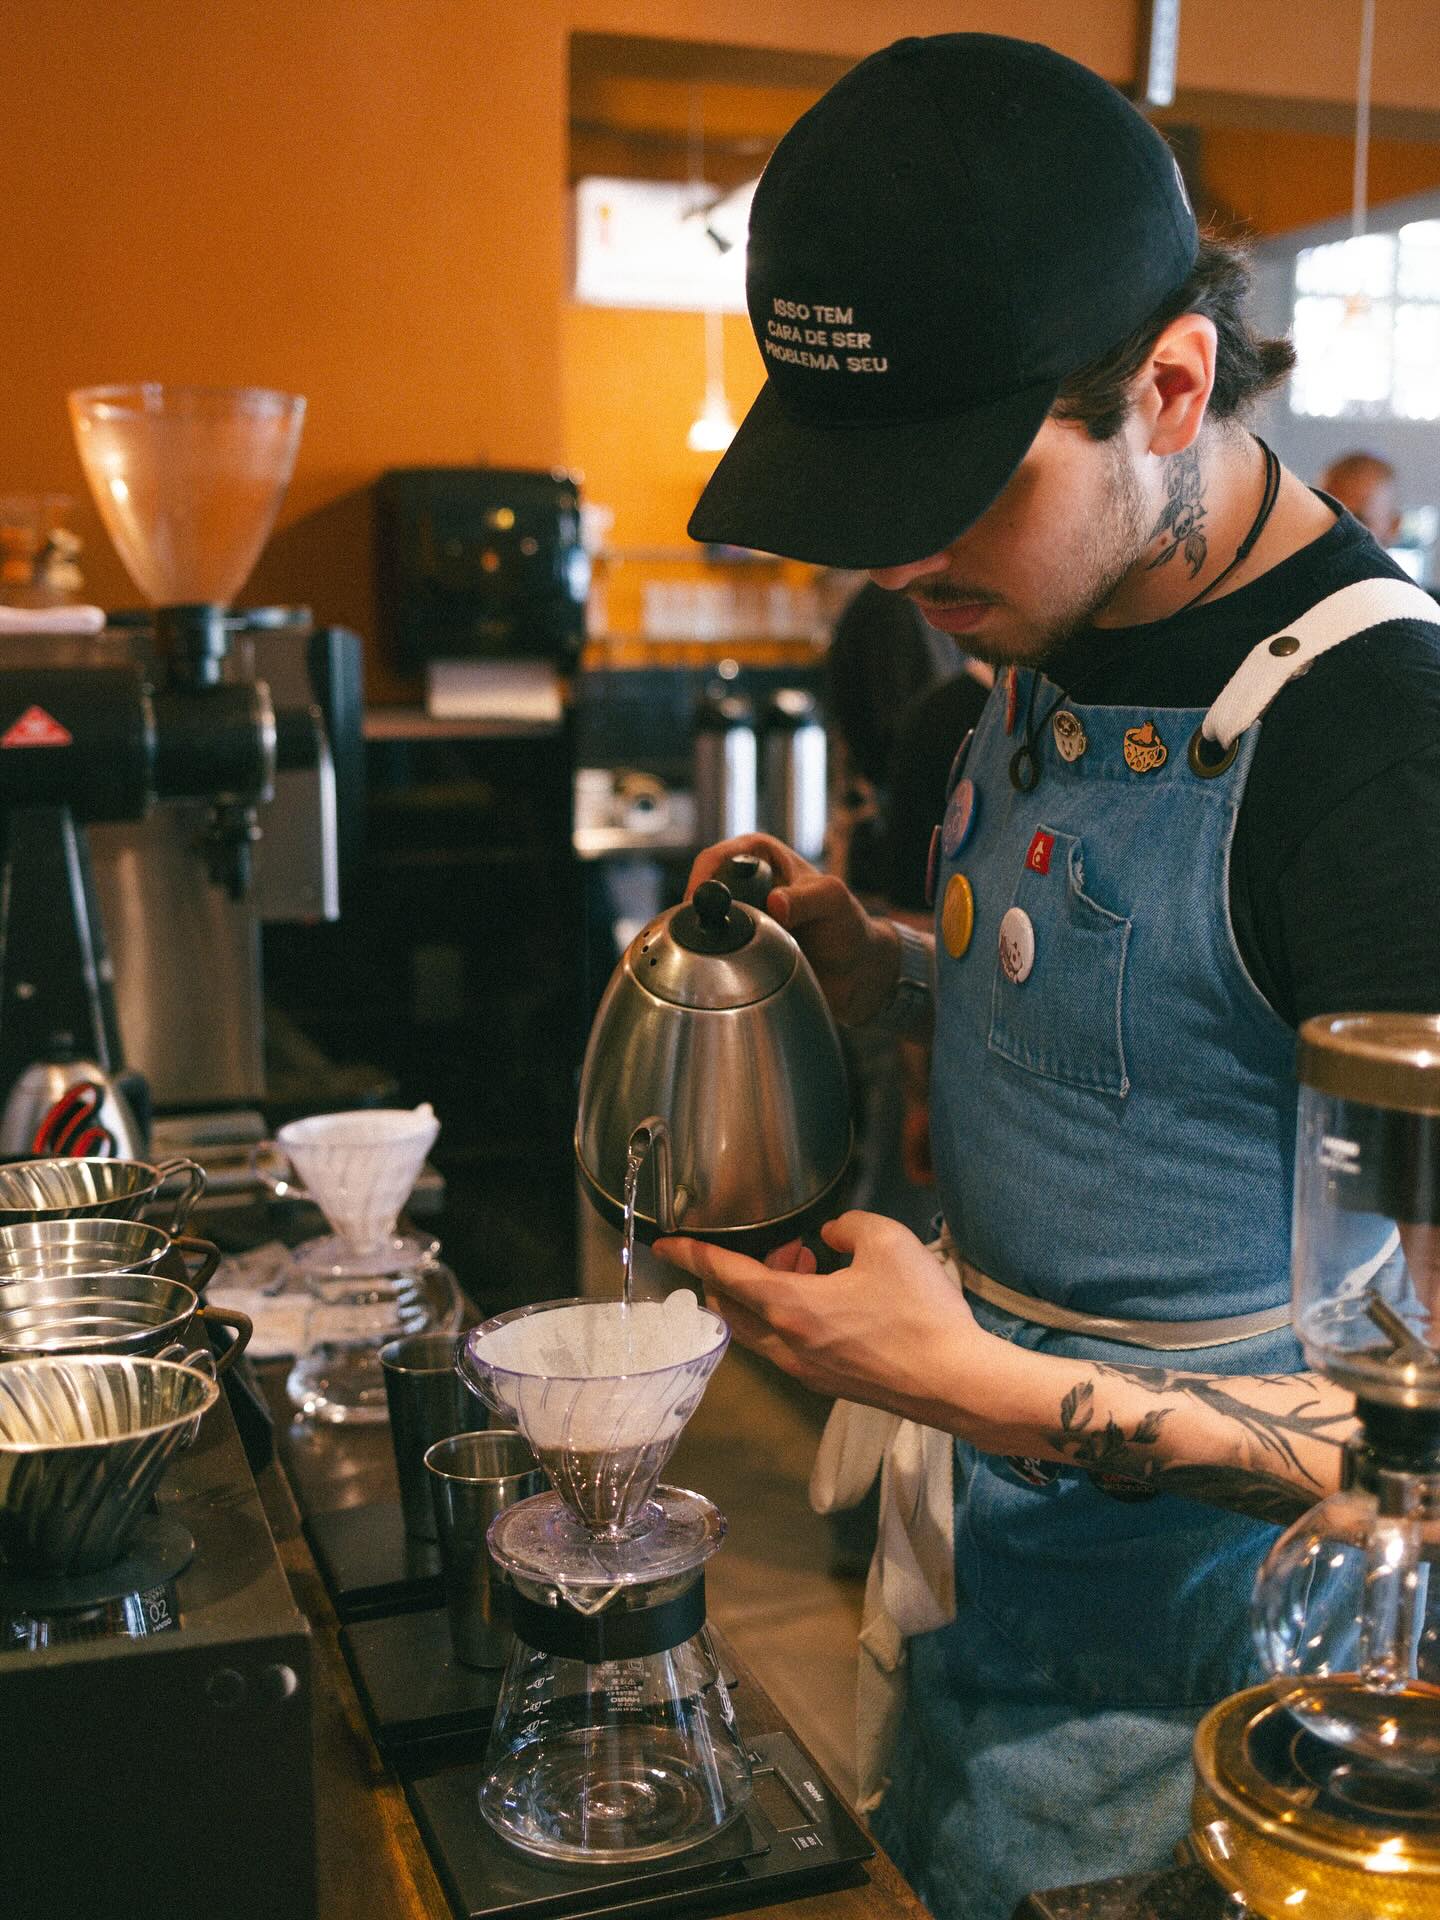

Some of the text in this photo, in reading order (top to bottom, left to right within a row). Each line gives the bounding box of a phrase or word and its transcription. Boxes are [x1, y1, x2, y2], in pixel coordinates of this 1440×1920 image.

[773, 298, 853, 325] ISSO TEM
[767, 320, 872, 349] CARA DE SER
[765, 339, 888, 373] PROBLEMA SEU
[150, 1599, 168, 1622] 02
